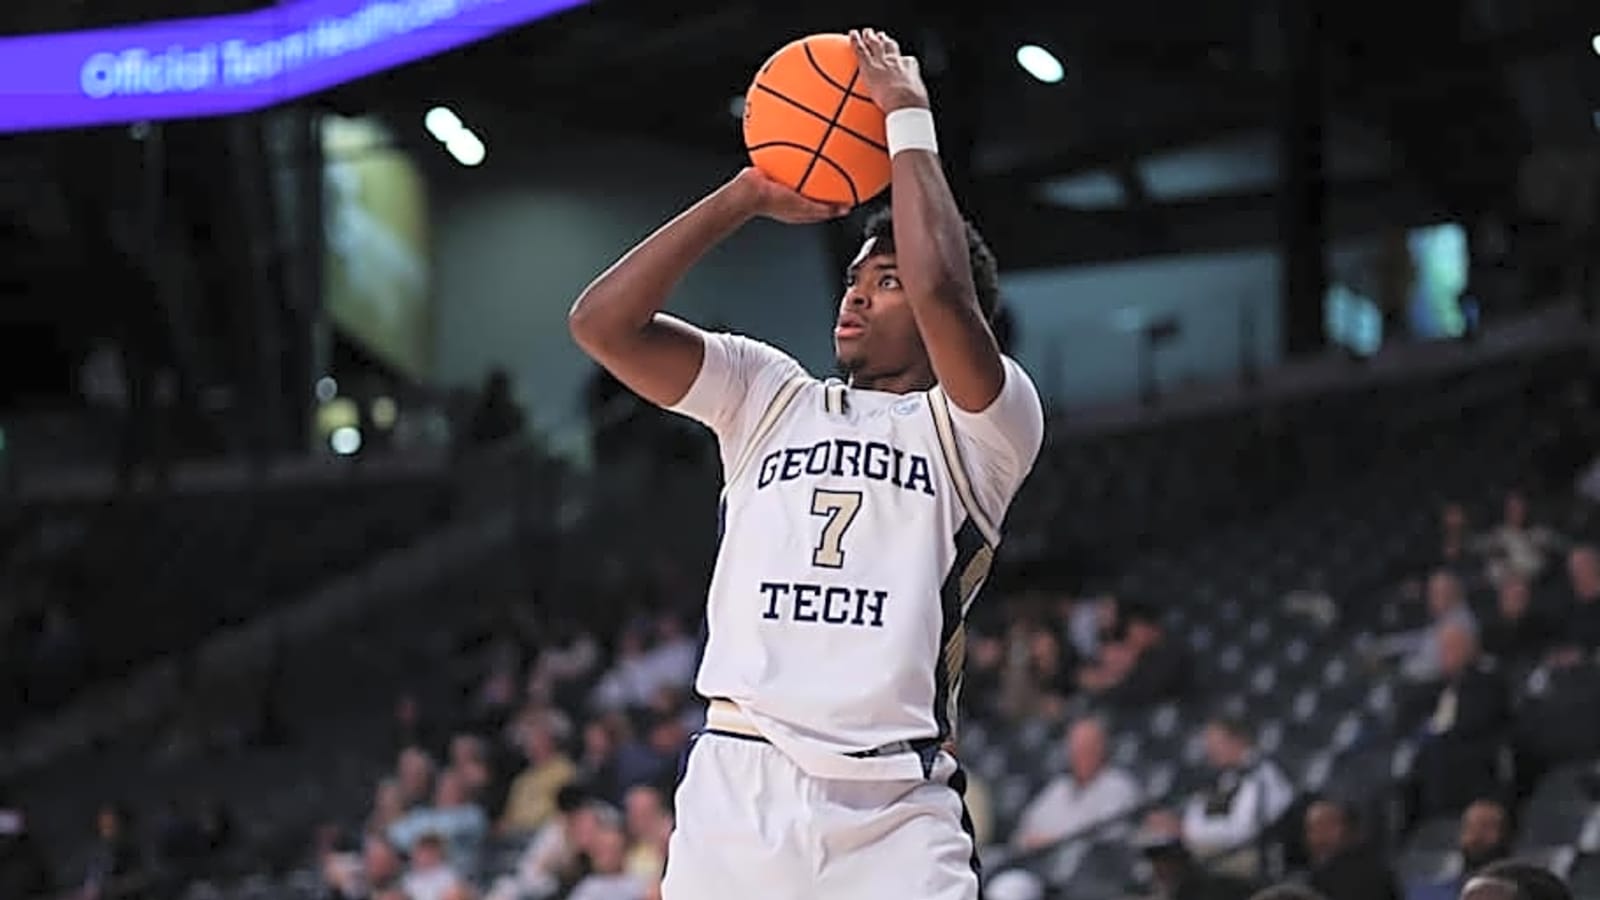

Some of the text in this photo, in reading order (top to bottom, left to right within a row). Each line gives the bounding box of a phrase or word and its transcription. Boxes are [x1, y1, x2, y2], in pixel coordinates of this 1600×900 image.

[81, 43, 218, 99] Official
[758, 439, 936, 497] GEORGIA
[810, 488, 863, 569] 7
[760, 583, 888, 627] TECH
